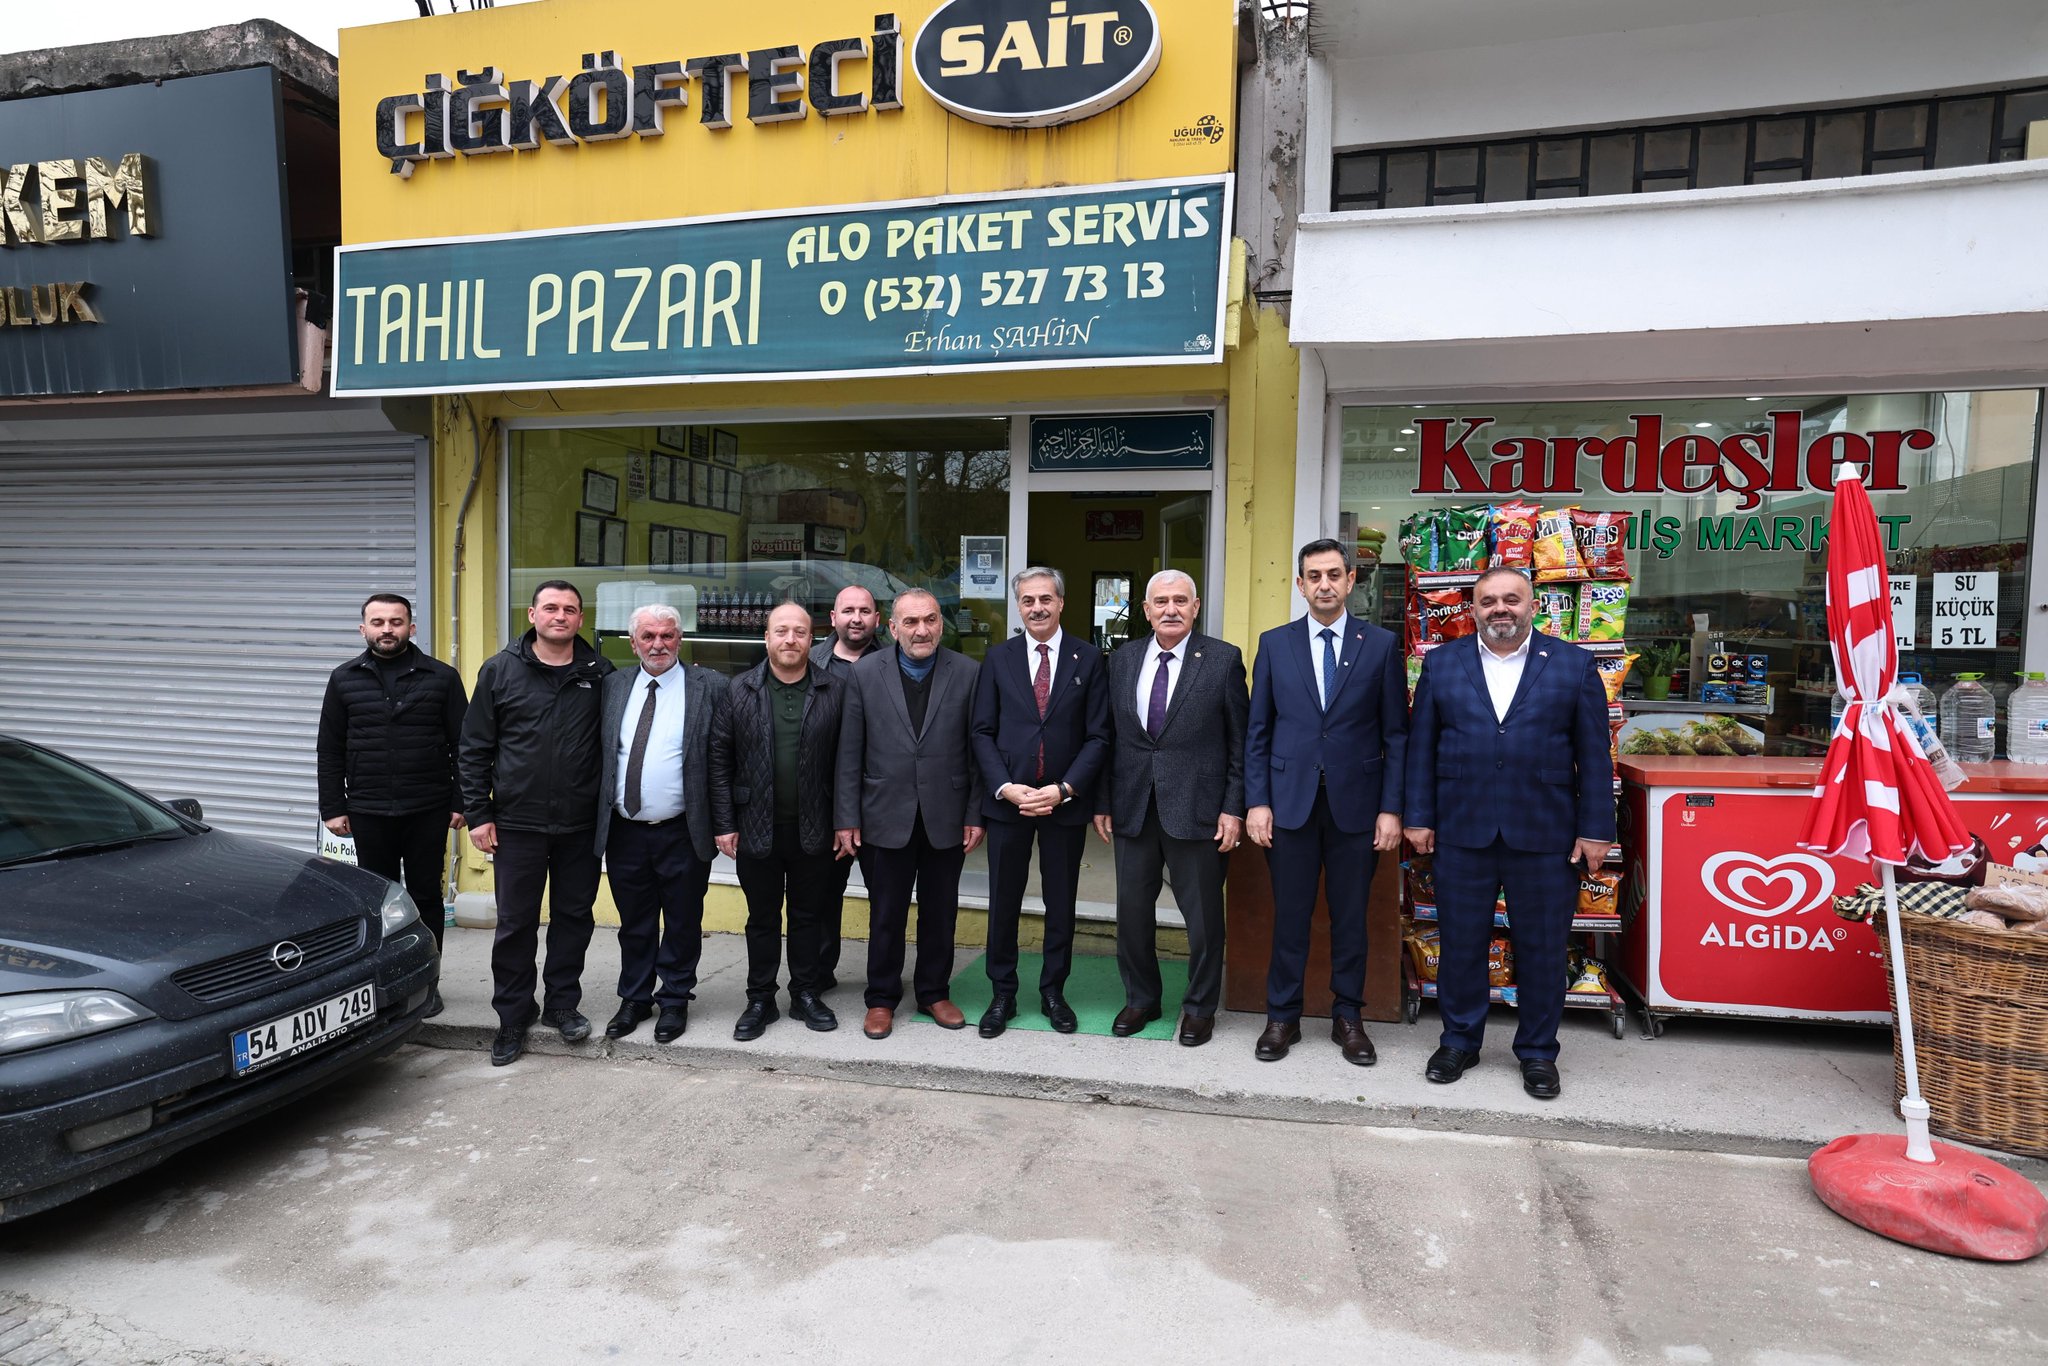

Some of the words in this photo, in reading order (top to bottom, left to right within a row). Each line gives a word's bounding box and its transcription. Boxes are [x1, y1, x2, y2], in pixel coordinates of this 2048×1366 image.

[376, 13, 904, 178] ÇİĞKÖFTECİ
[1174, 126, 1202, 137] UĞUR
[787, 222, 871, 269] ALO
[886, 211, 1033, 261] PAKET
[1046, 189, 1210, 248] SERVİS
[819, 280, 847, 316] 0
[864, 273, 963, 322] (532)
[980, 268, 1050, 307] 527
[1061, 264, 1108, 303] 73
[1122, 261, 1166, 299] 13
[346, 278, 500, 365] TAHIL
[527, 258, 762, 357] PAZARI
[904, 323, 983, 353] Erhan
[990, 315, 1100, 358] ŞAHİN
[1410, 408, 1935, 512] Kardeşler
[1697, 515, 1912, 552] MARKT
[1954, 575, 1977, 592] SU
[1426, 603, 1462, 617] Doritos
[1935, 597, 1995, 621] KÜÇÜK
[1941, 627, 1954, 645] 5
[1960, 628, 1987, 645] TL
[325, 842, 338, 854] Alo
[340, 843, 355, 856] Pak
[250, 1024, 278, 1060] 54
[292, 1004, 327, 1044] ADV
[339, 988, 371, 1024] 249
[237, 1051, 248, 1063] TR
[289, 1037, 328, 1057] ANALİZ
[328, 1026, 348, 1040] OTO
